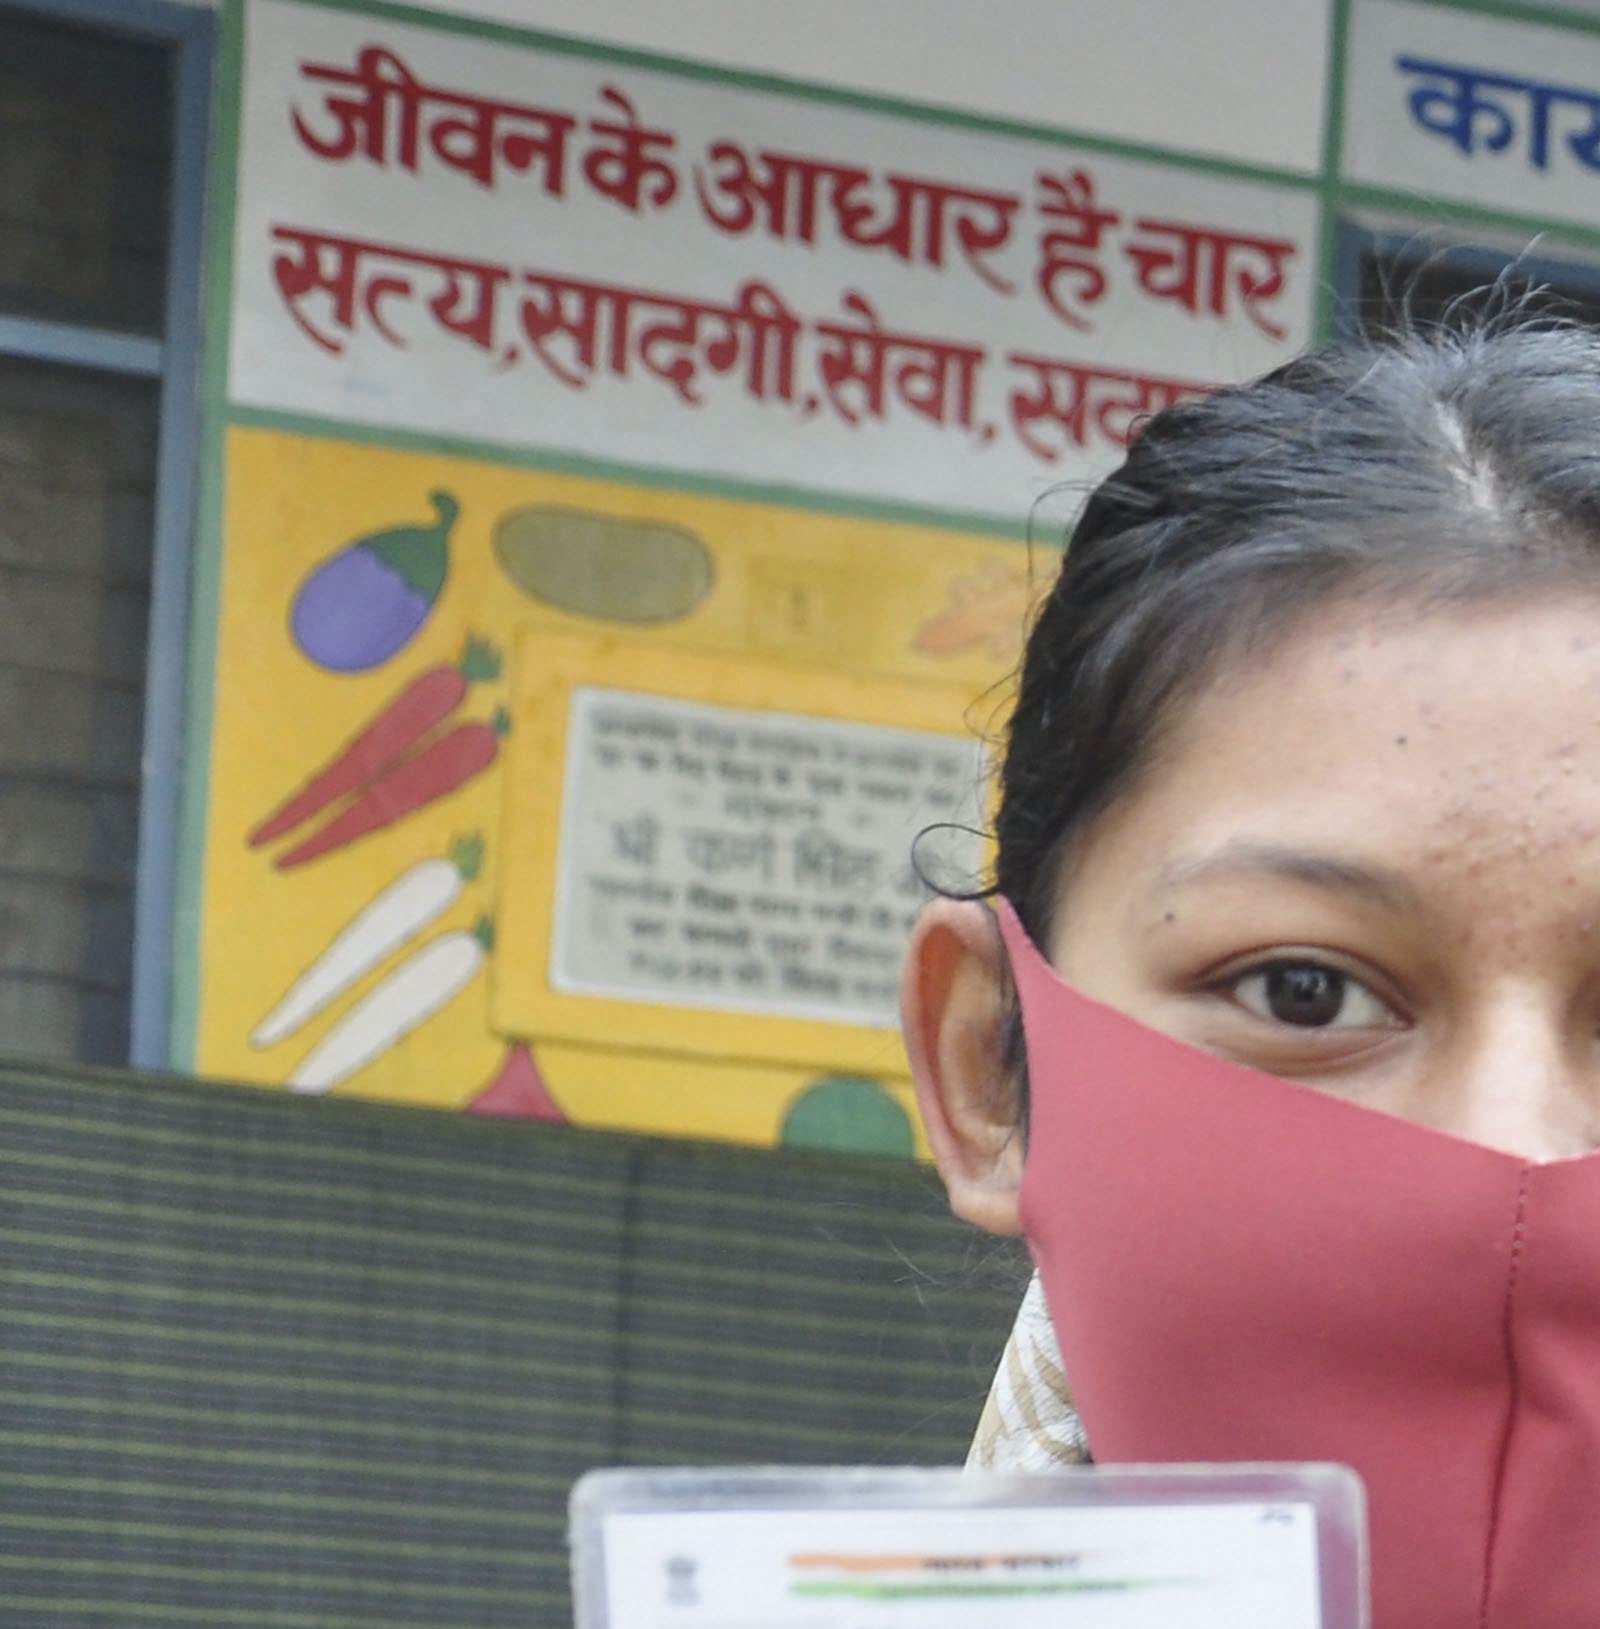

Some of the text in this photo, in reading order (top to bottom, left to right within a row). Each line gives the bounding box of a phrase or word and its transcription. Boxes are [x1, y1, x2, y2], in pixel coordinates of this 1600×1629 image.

[292, 43, 1294, 343] जीवन के आधार है चार
